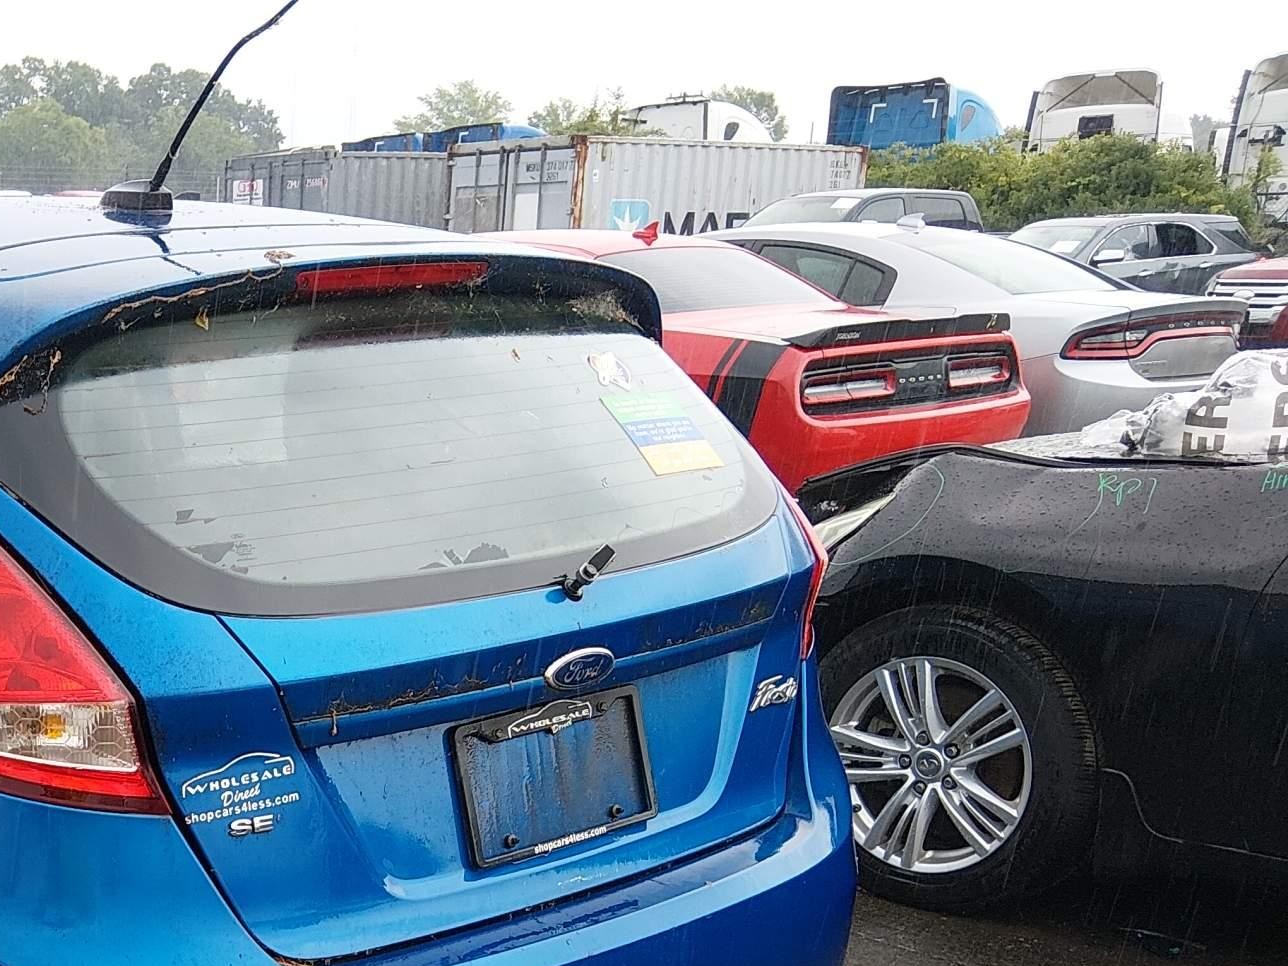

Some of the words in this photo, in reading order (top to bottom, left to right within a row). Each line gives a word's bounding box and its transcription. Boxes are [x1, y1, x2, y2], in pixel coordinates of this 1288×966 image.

[563, 657, 602, 683] Ford
[511, 708, 590, 733] WHOLESALE
[186, 764, 292, 795] WHOLESALE
[184, 791, 299, 825] shopcars4less.com
[220, 782, 261, 808] Direct
[228, 814, 274, 837] SE
[534, 825, 608, 855] shopcars4less.com
